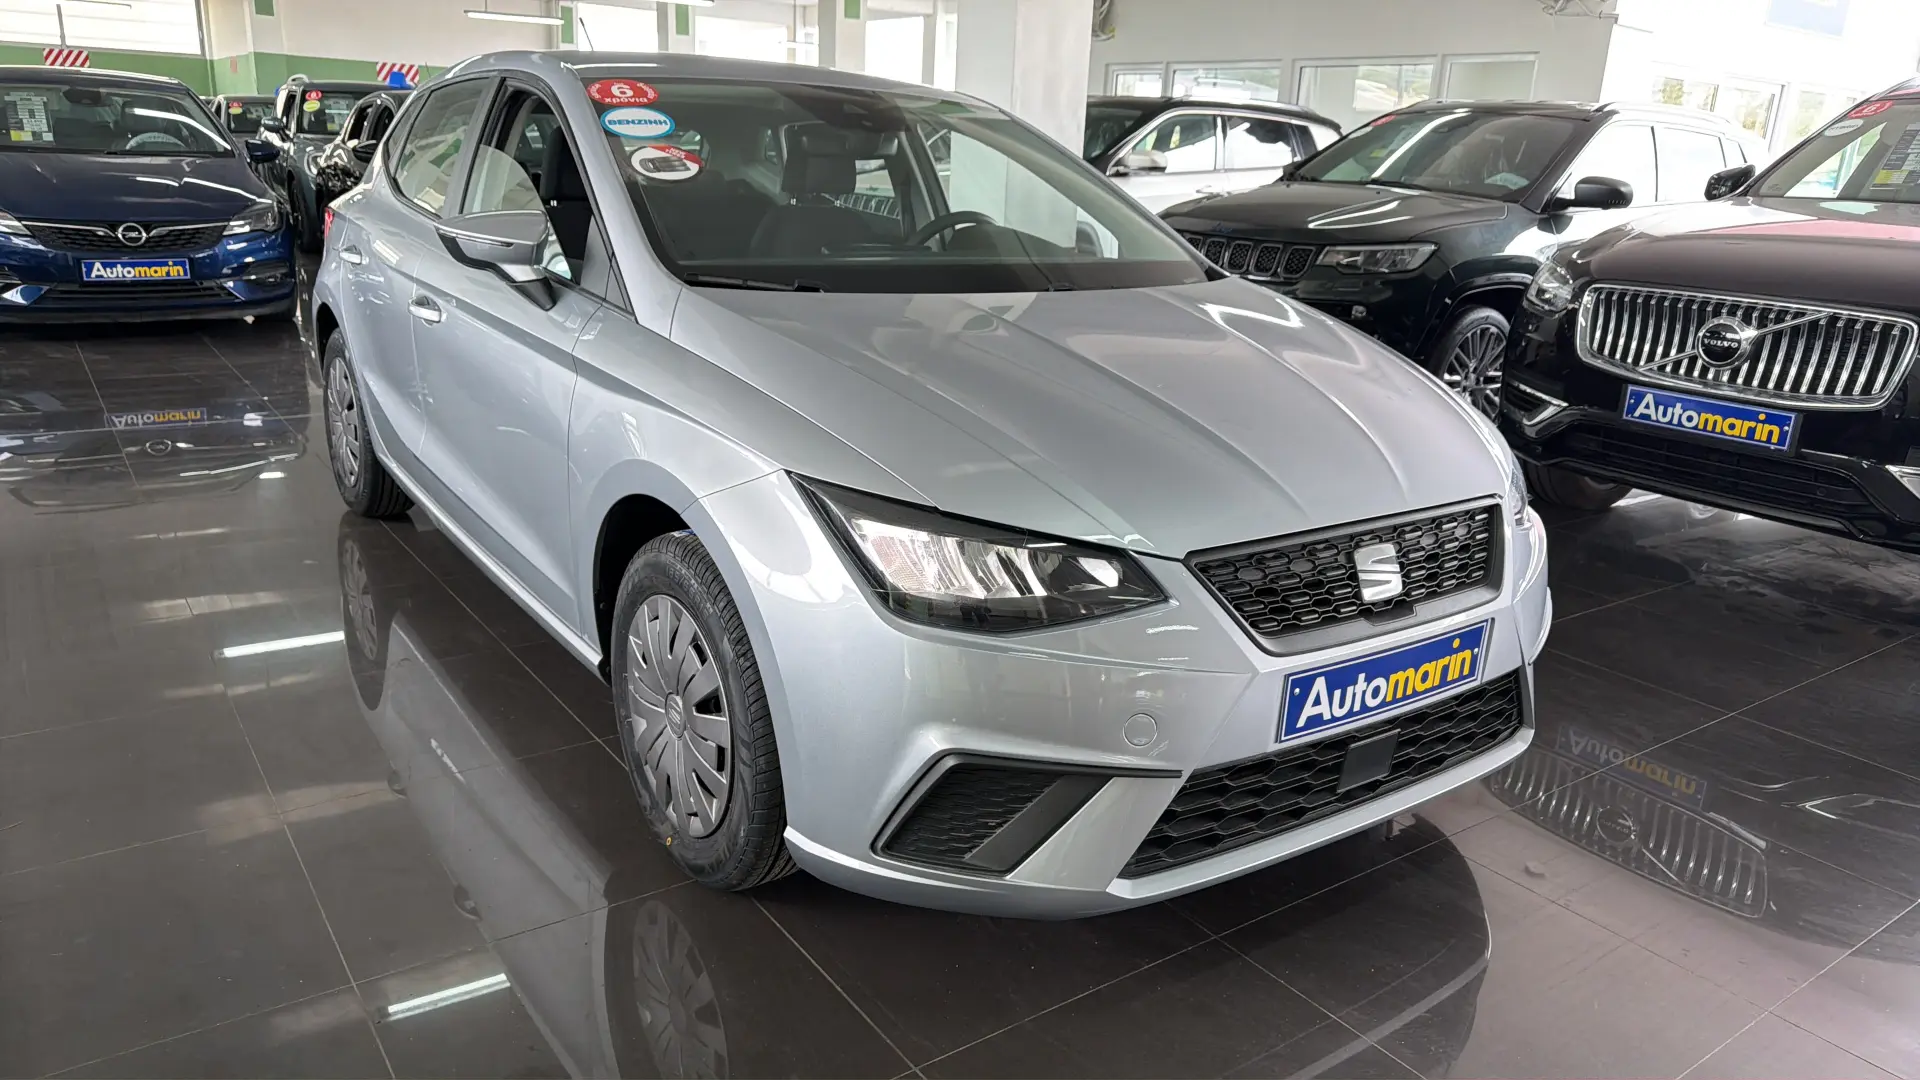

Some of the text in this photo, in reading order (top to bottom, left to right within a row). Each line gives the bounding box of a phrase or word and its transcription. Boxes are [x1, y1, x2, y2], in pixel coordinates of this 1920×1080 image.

[611, 84, 634, 97] 6
[604, 96, 648, 104] χρόνια
[91, 260, 184, 278] Automarin
[1703, 338, 1739, 349] VOLVO
[1633, 393, 1780, 444] Automarin
[1296, 638, 1472, 728] Automarin
